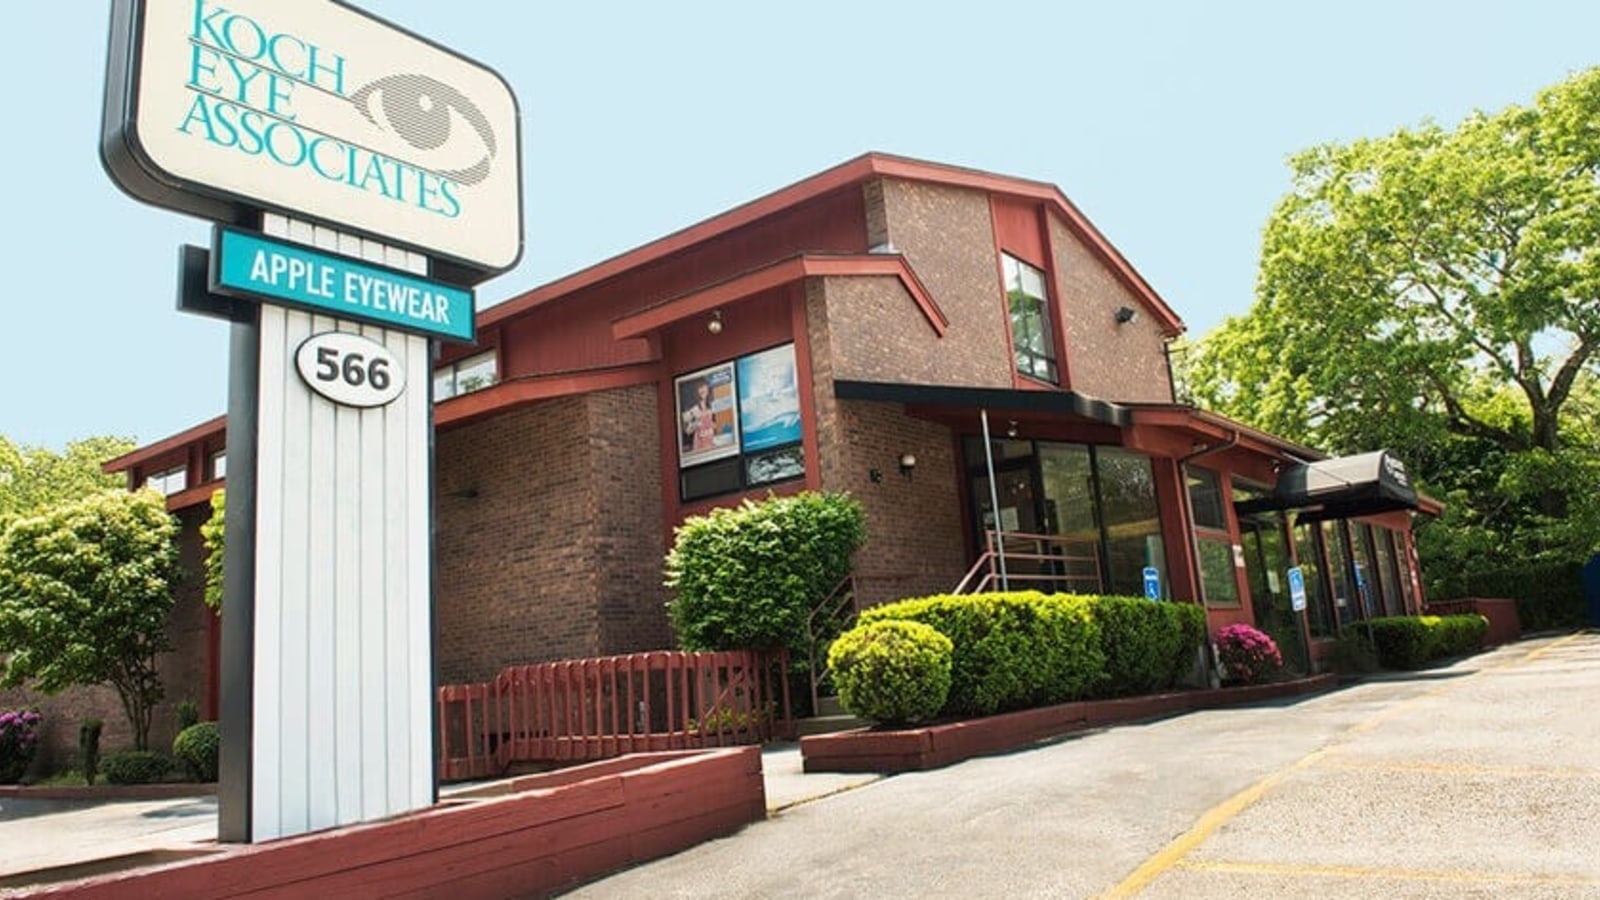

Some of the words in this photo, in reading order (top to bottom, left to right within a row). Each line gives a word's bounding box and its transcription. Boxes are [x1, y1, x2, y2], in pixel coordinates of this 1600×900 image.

[190, 44, 296, 121] EYE
[191, 0, 345, 94] KOCH
[177, 94, 461, 218] ASSOCIATES
[250, 250, 335, 298] APPLE
[345, 273, 450, 325] EYEWEAR
[316, 347, 391, 390] 566
